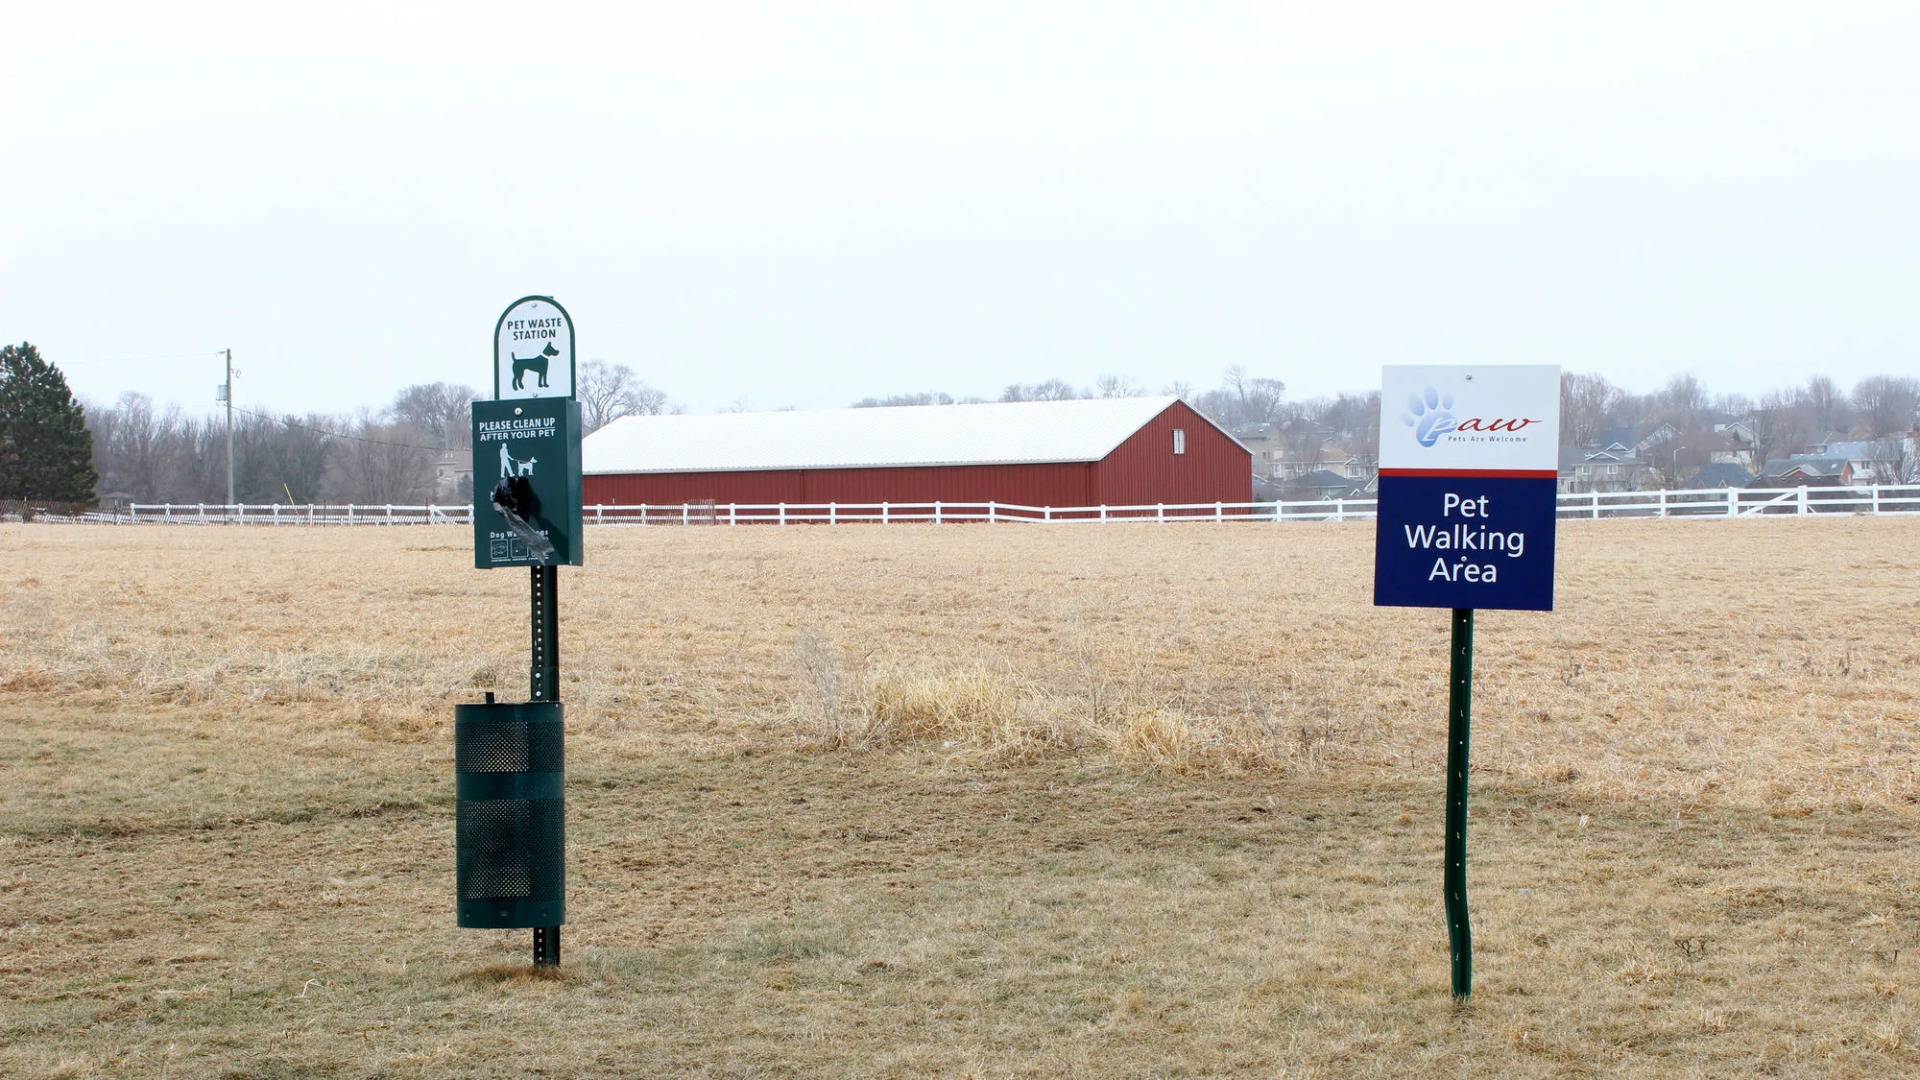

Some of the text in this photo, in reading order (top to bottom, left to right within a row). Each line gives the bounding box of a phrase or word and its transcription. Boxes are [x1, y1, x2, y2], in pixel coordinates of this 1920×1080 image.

[507, 318, 561, 330] PET WASTE
[513, 329, 556, 340] STATION
[480, 417, 556, 431] PLEASE CLEAN UP
[480, 428, 556, 442] AFTER YOUR PET
[1443, 492, 1489, 518] Pet
[1404, 524, 1524, 558] Walking
[1428, 557, 1497, 583] Area
